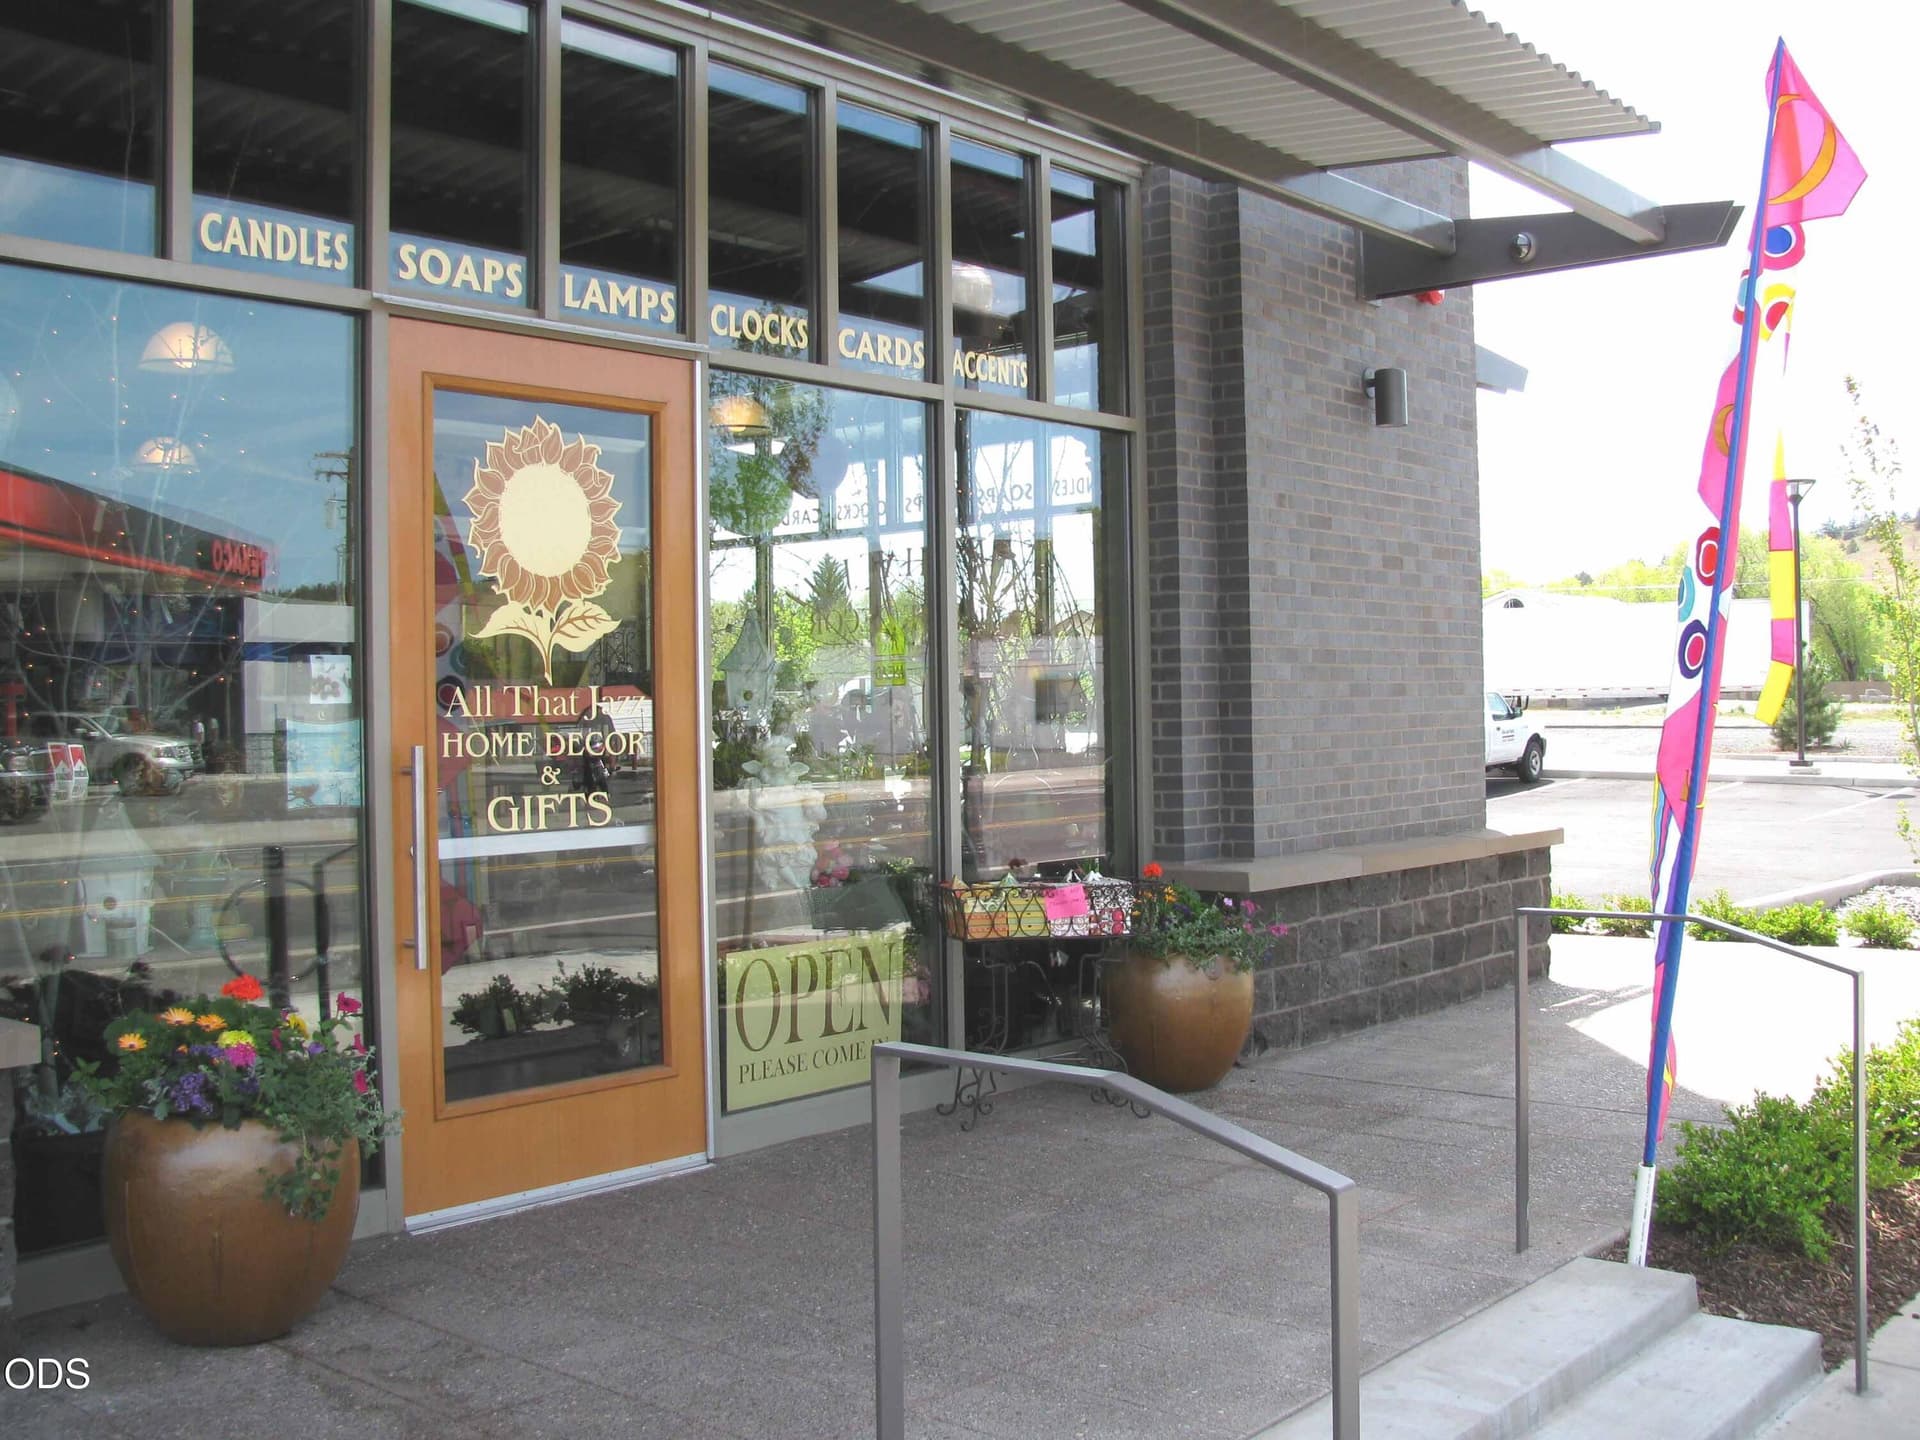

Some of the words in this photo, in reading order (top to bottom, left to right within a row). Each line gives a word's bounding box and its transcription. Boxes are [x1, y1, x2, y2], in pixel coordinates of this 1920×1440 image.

[200, 213, 349, 271] CANDLES
[399, 243, 523, 299] SOAPS
[563, 274, 675, 324] LAMPS
[711, 303, 808, 349] CLOCKS
[838, 328, 924, 370] CARDS
[952, 349, 1028, 388] ACCENTS
[444, 685, 492, 718] All
[503, 685, 579, 718] That
[583, 685, 646, 721] Jazz
[442, 732, 535, 758] HOME
[545, 731, 647, 757] DECOR
[541, 765, 561, 785] &
[487, 791, 613, 832] GIFTS
[735, 942, 898, 1052] OPEN
[739, 1058, 808, 1085] PLEASE
[813, 1045, 867, 1069] COME
